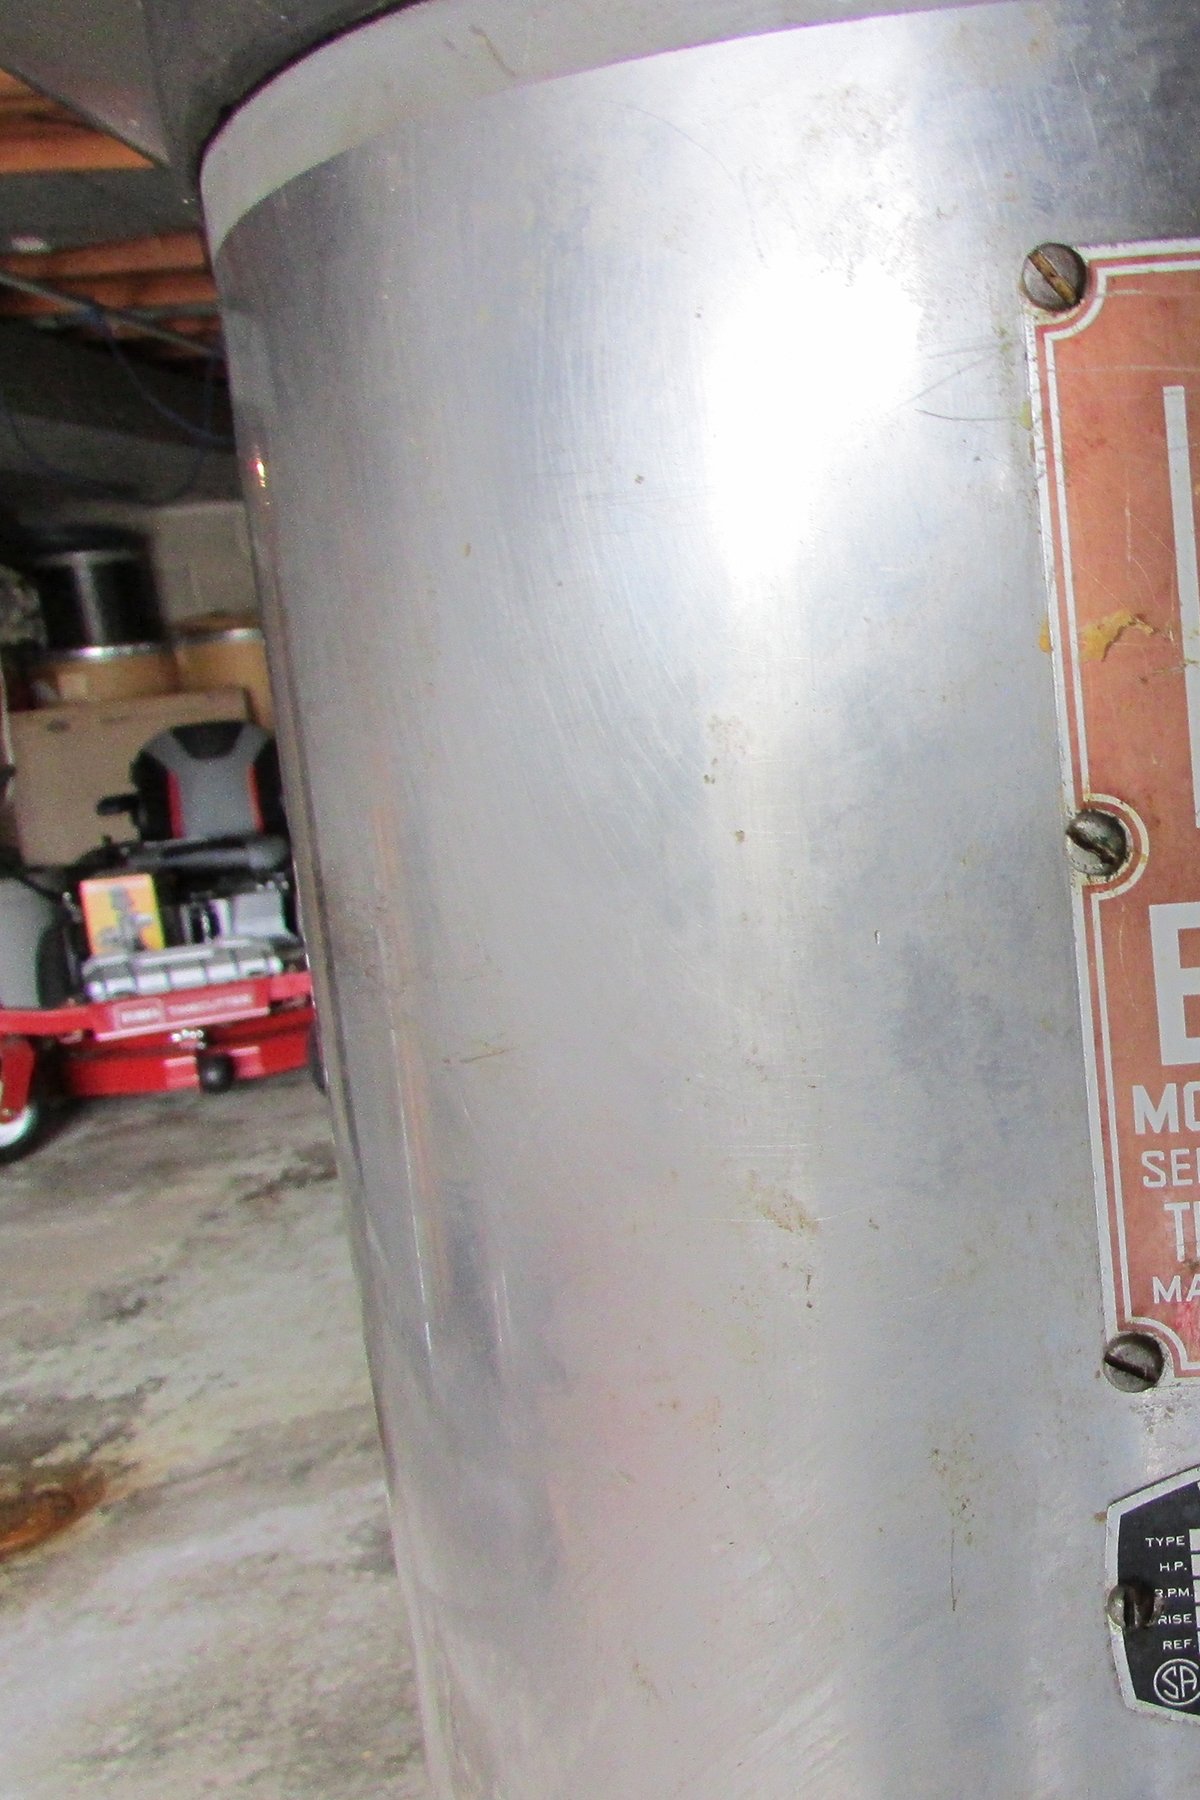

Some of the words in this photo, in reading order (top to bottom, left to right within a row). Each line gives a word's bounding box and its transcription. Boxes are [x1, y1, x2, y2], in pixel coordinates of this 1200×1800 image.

[1145, 1535, 1186, 1548] TYPE
[1159, 1562, 1188, 1573] H.P.
[1157, 1614, 1193, 1625] RISE
[1163, 1638, 1197, 1650] REF.
